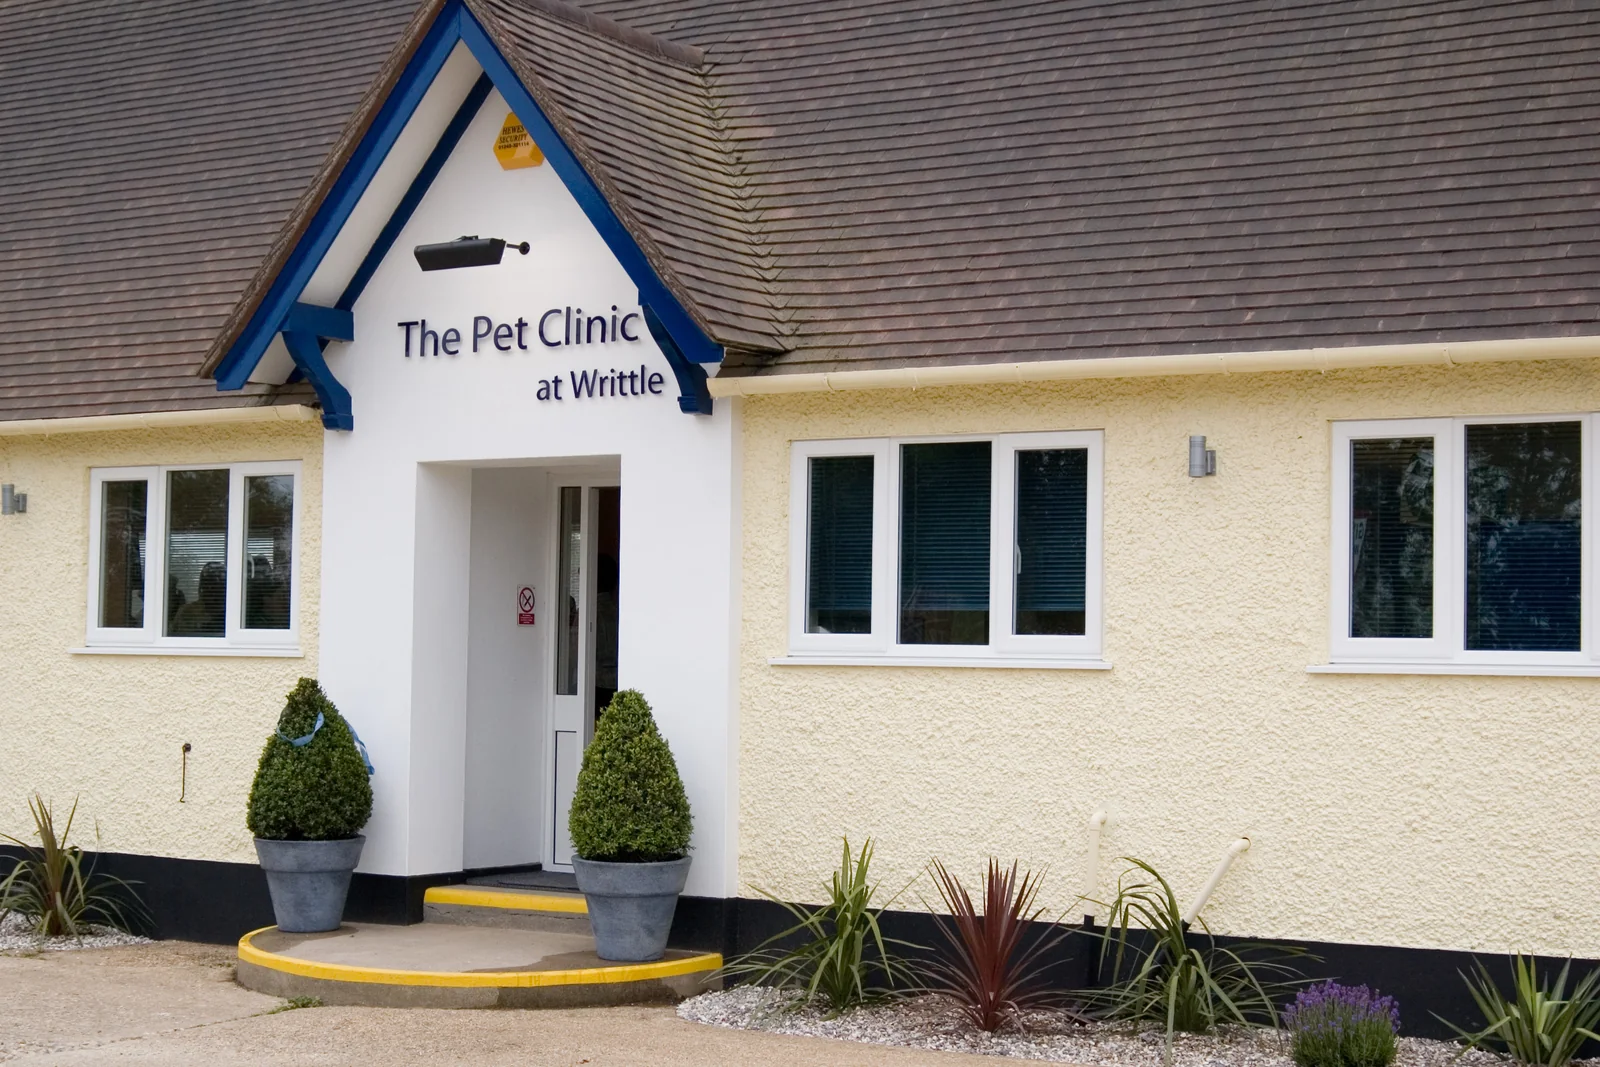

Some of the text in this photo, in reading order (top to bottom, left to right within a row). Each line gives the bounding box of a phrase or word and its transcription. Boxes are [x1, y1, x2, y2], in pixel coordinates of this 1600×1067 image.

[499, 133, 528, 144] SECURITY
[397, 304, 641, 358] The Pet Clinic
[536, 364, 666, 401] at Writtle
